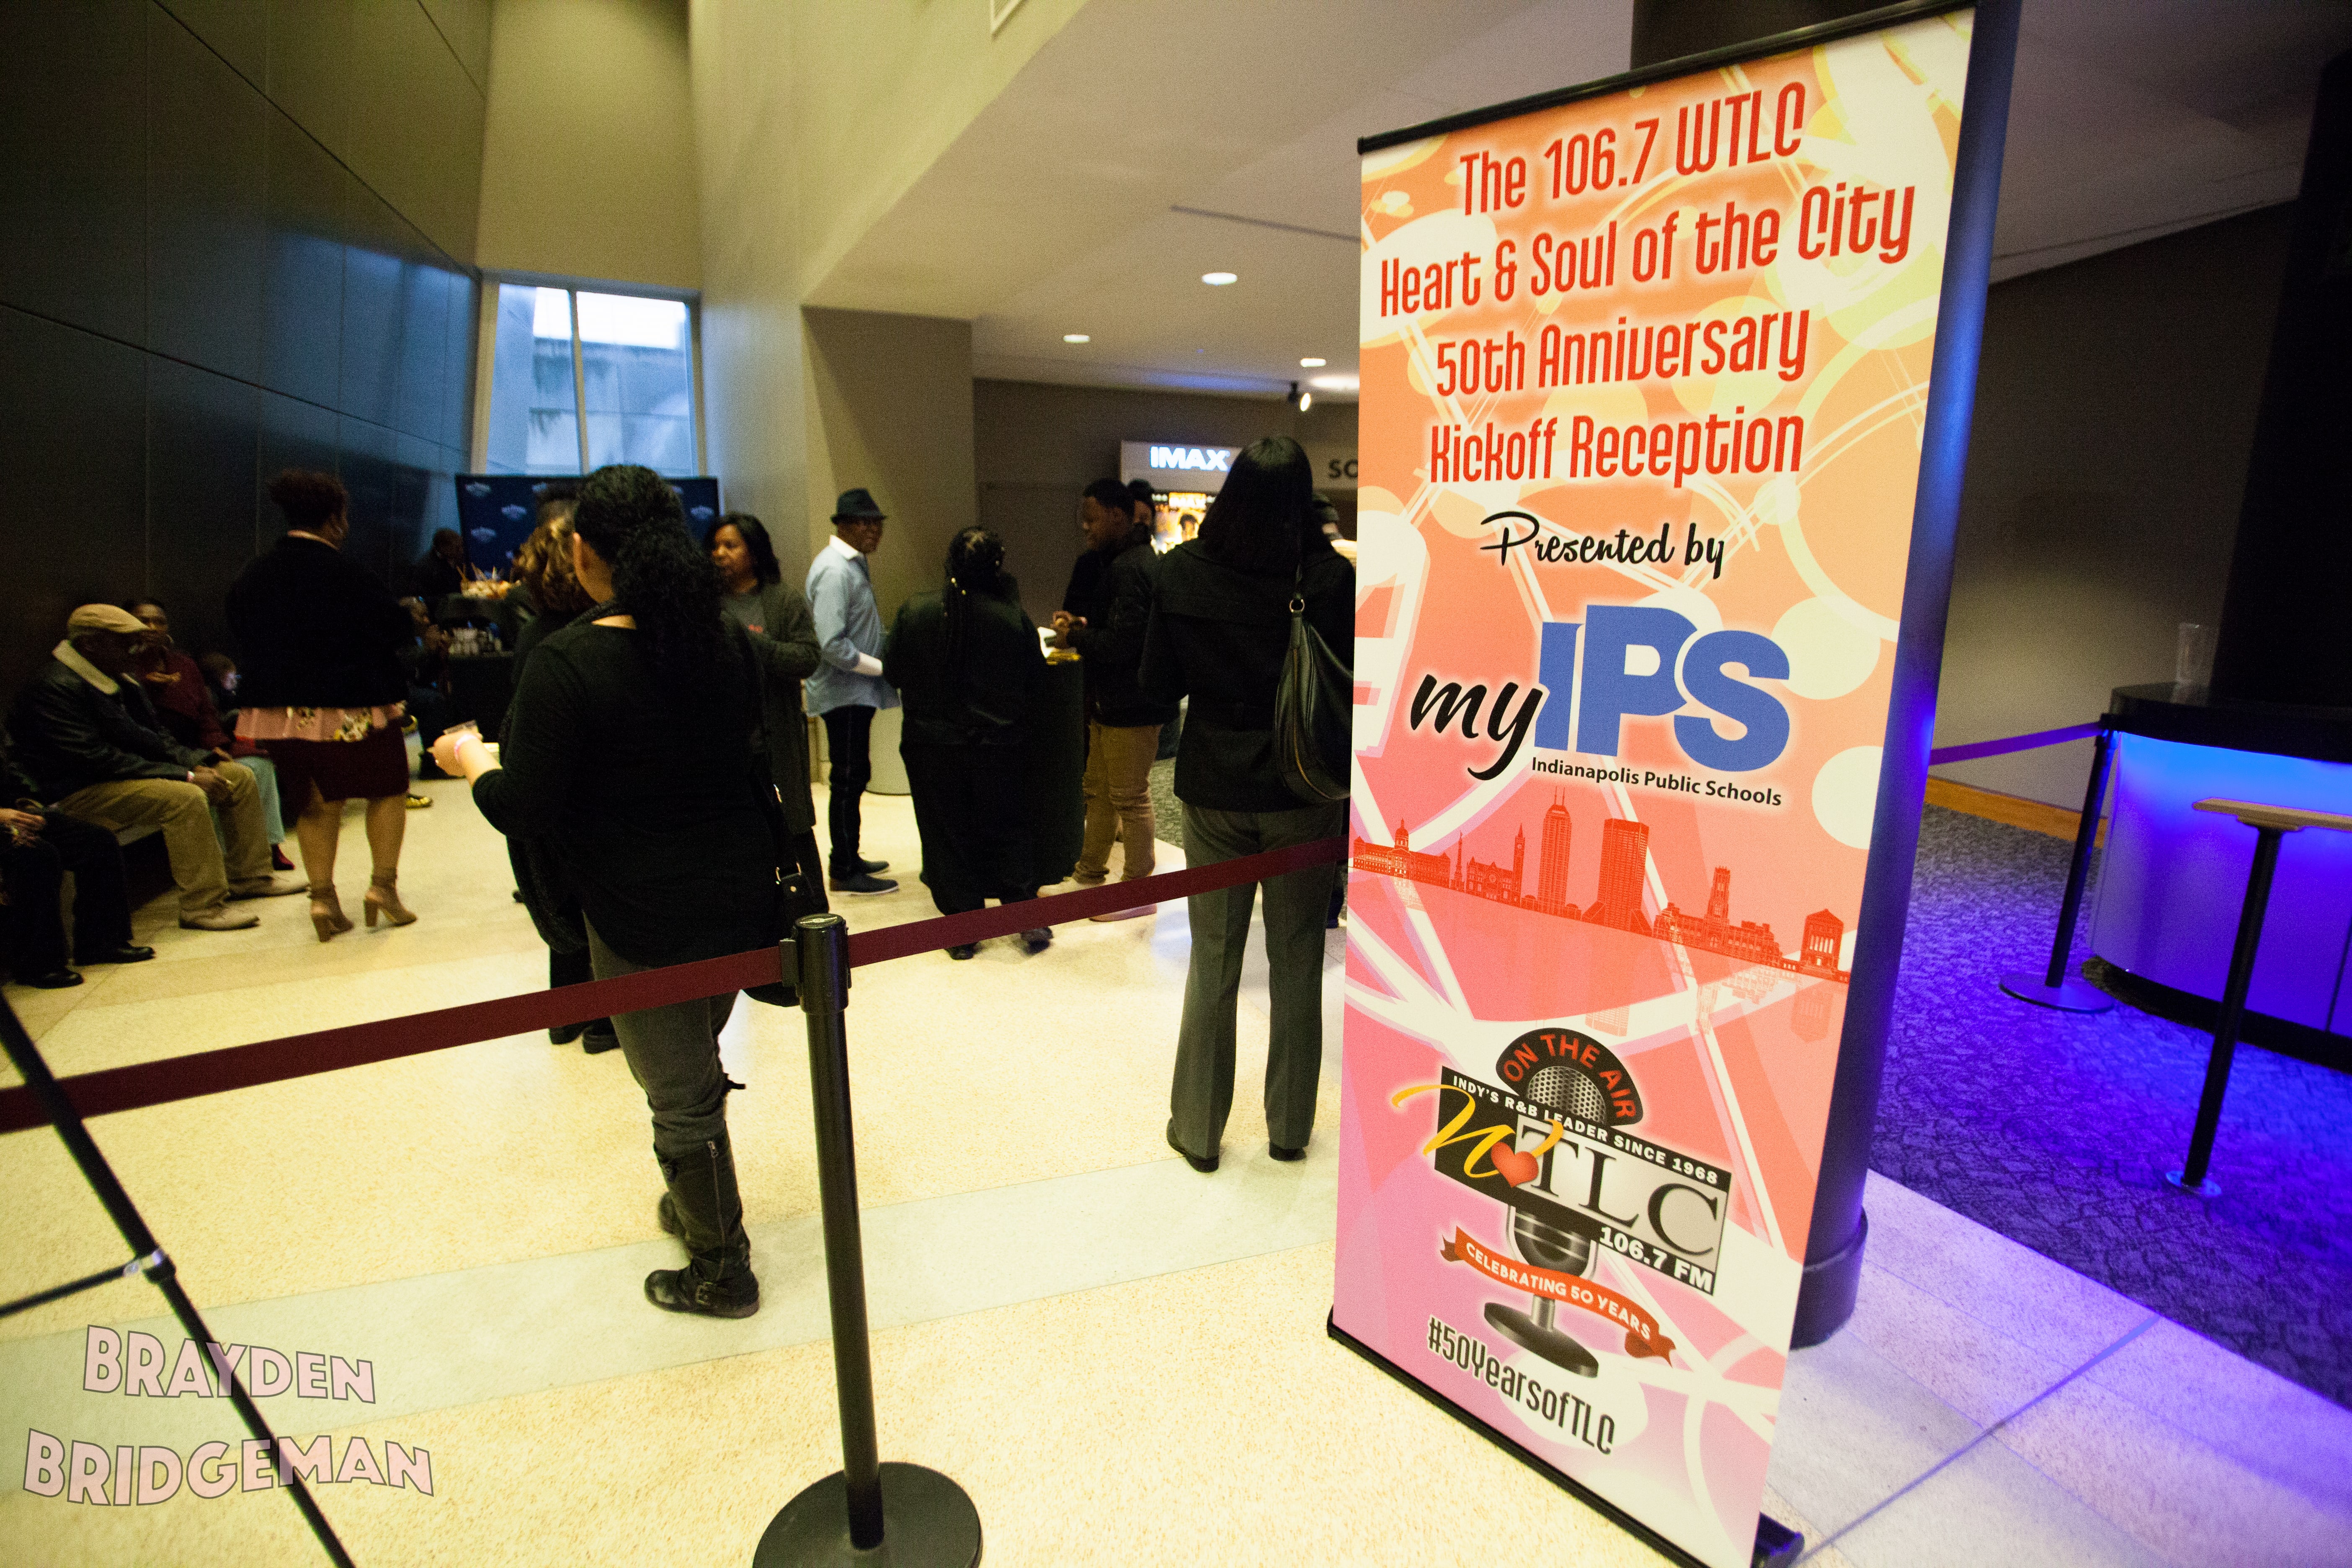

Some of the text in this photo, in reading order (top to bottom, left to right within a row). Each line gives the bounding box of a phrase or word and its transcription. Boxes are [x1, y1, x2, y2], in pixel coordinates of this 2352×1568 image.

[1460, 82, 1805, 215] The 106.7 WTLC
[1380, 182, 1915, 317] Heart & Soul of the City
[1436, 309, 1810, 397] 50th Anniversary
[1150, 446, 1228, 472] IMAX
[1431, 406, 1804, 488] Kickoff Reception
[1480, 511, 1724, 580] Presented by
[1532, 757, 1782, 806] Indianapolis Public Schools
[1504, 1034, 1636, 1118] ON THE AIR
[1453, 1075, 1718, 1185] INDY'S R&B LEADER SINCE 1968
[1466, 1242, 1651, 1340] CELEBRATING 50 YEARS
[1599, 1226, 1714, 1294] 106.7 FM
[1429, 1317, 1615, 1455] #50YearsofTLC
